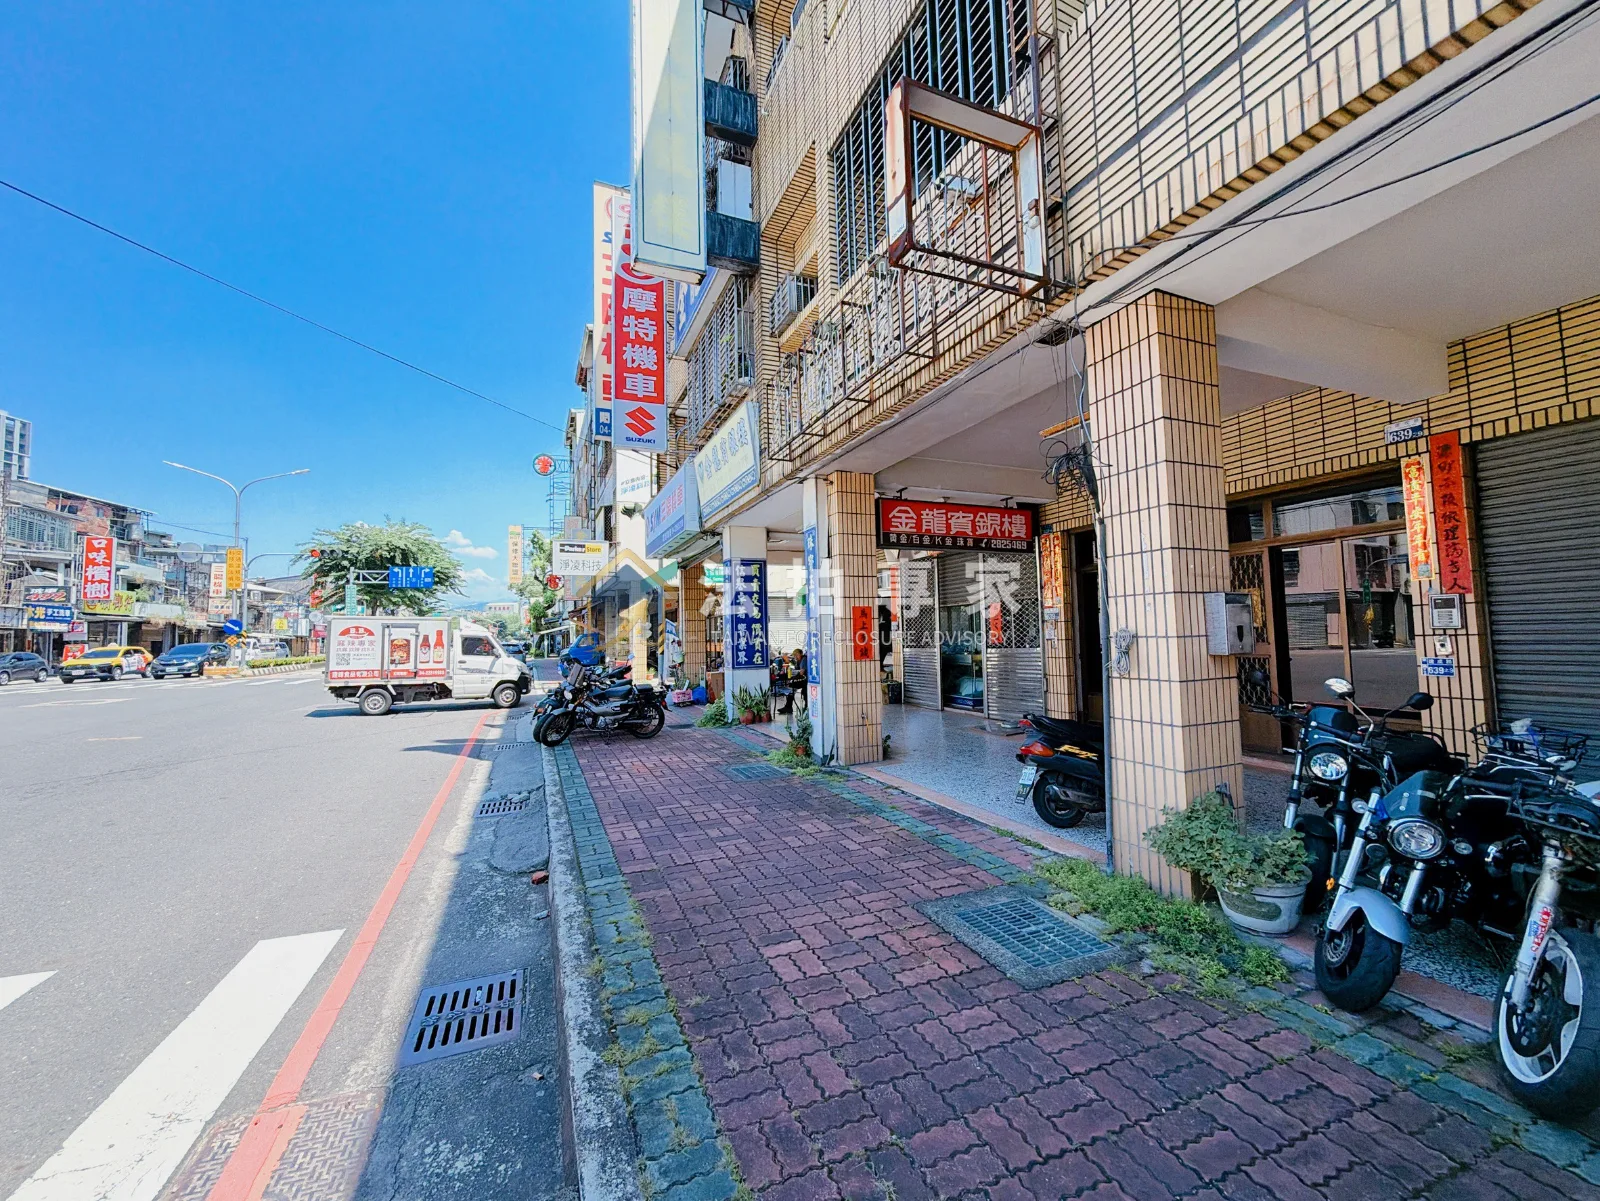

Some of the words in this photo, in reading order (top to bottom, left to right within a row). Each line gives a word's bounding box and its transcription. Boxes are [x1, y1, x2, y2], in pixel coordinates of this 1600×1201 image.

[622, 287, 658, 398] 摩特機車
[625, 436, 656, 444] SUZUKI
[85, 539, 111, 598] 口味檳榔
[559, 558, 603, 572] 淨凌科技
